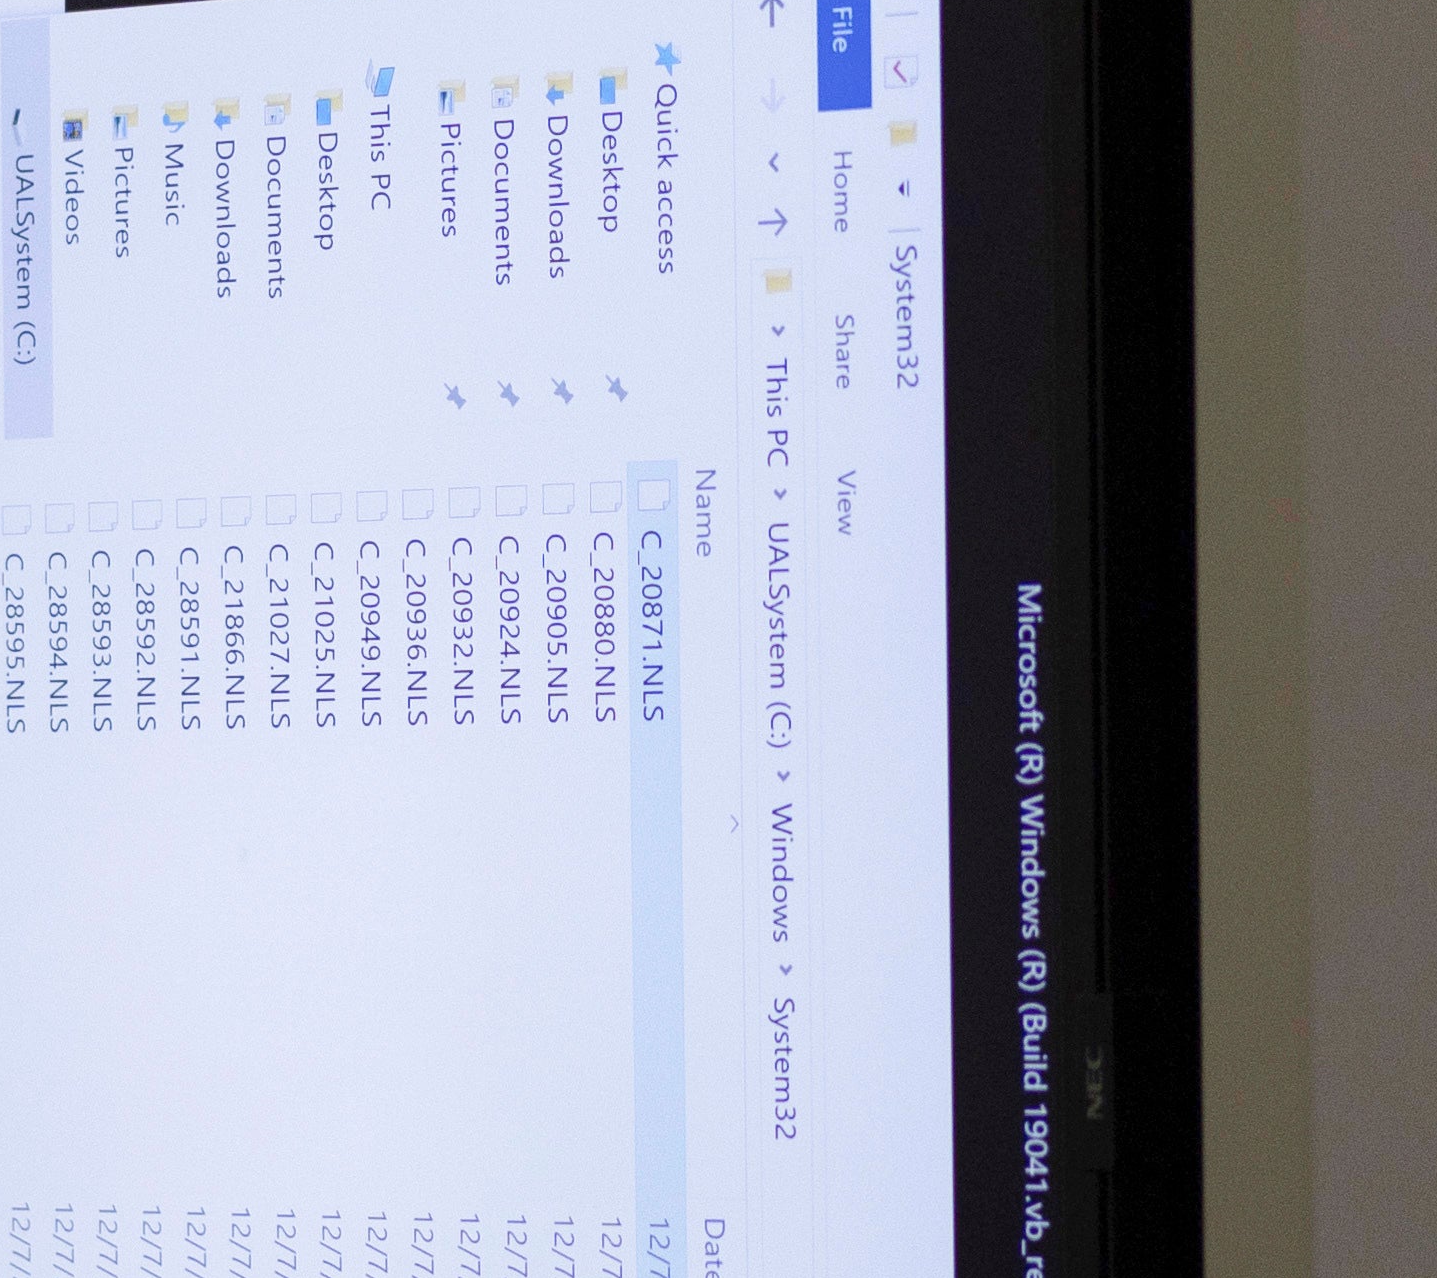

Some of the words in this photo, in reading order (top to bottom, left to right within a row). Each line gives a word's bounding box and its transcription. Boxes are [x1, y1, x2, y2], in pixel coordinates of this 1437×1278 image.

[830, 4, 854, 55] File
[58, 145, 86, 247] Videos
[163, 142, 187, 227] Music
[312, 131, 341, 252] Desktop
[369, 103, 393, 164] This
[369, 172, 393, 212] PC
[439, 121, 463, 239] Pictures
[546, 114, 572, 280] Downloads
[596, 109, 625, 234] Desktop
[653, 82, 680, 171] Quick
[832, 149, 854, 234] Home
[9, 153, 36, 311] UALSystem
[113, 146, 136, 260] Pictures
[214, 138, 238, 300] Downloads
[265, 134, 288, 301] Documents
[492, 118, 516, 287] Documents
[656, 178, 675, 276] access
[12, 320, 38, 367] (C:)
[765, 356, 790, 419] This
[834, 313, 856, 391] Share
[888, 243, 921, 390] System32
[694, 468, 718, 558] Name
[765, 428, 790, 468] PC
[836, 468, 858, 537] View
[0, 551, 27, 735] C_28595.NLS
[43, 550, 70, 734] C_28594.NLS
[87, 548, 114, 734] C_28593.NLS
[130, 547, 158, 733] C_28592.NLS
[174, 545, 202, 732] C_28591.NLS
[219, 544, 247, 731] C_21866.NLS
[264, 542, 292, 730] C_21027.NLS
[309, 540, 338, 729] C_21025.NLS
[355, 539, 383, 728] C_20949.NLS
[400, 537, 430, 728] C_20936.NLS
[447, 535, 476, 727] C_20932.NLS
[493, 534, 523, 726] C_20924.NLS
[540, 532, 570, 725] C_20905.NLS
[588, 530, 618, 724] C_20880.NLS
[636, 528, 666, 723] C_20871.NLS
[761, 521, 792, 691] UALSystem
[1017, 582, 1044, 735] Microsoft
[764, 700, 793, 750] (C:)
[1015, 742, 1044, 786] (R)
[770, 801, 796, 944] Windows
[1018, 794, 1045, 940] Windows
[1017, 948, 1047, 994] (R)
[766, 996, 798, 1141] System32
[1018, 1002, 1049, 1092] (Build
